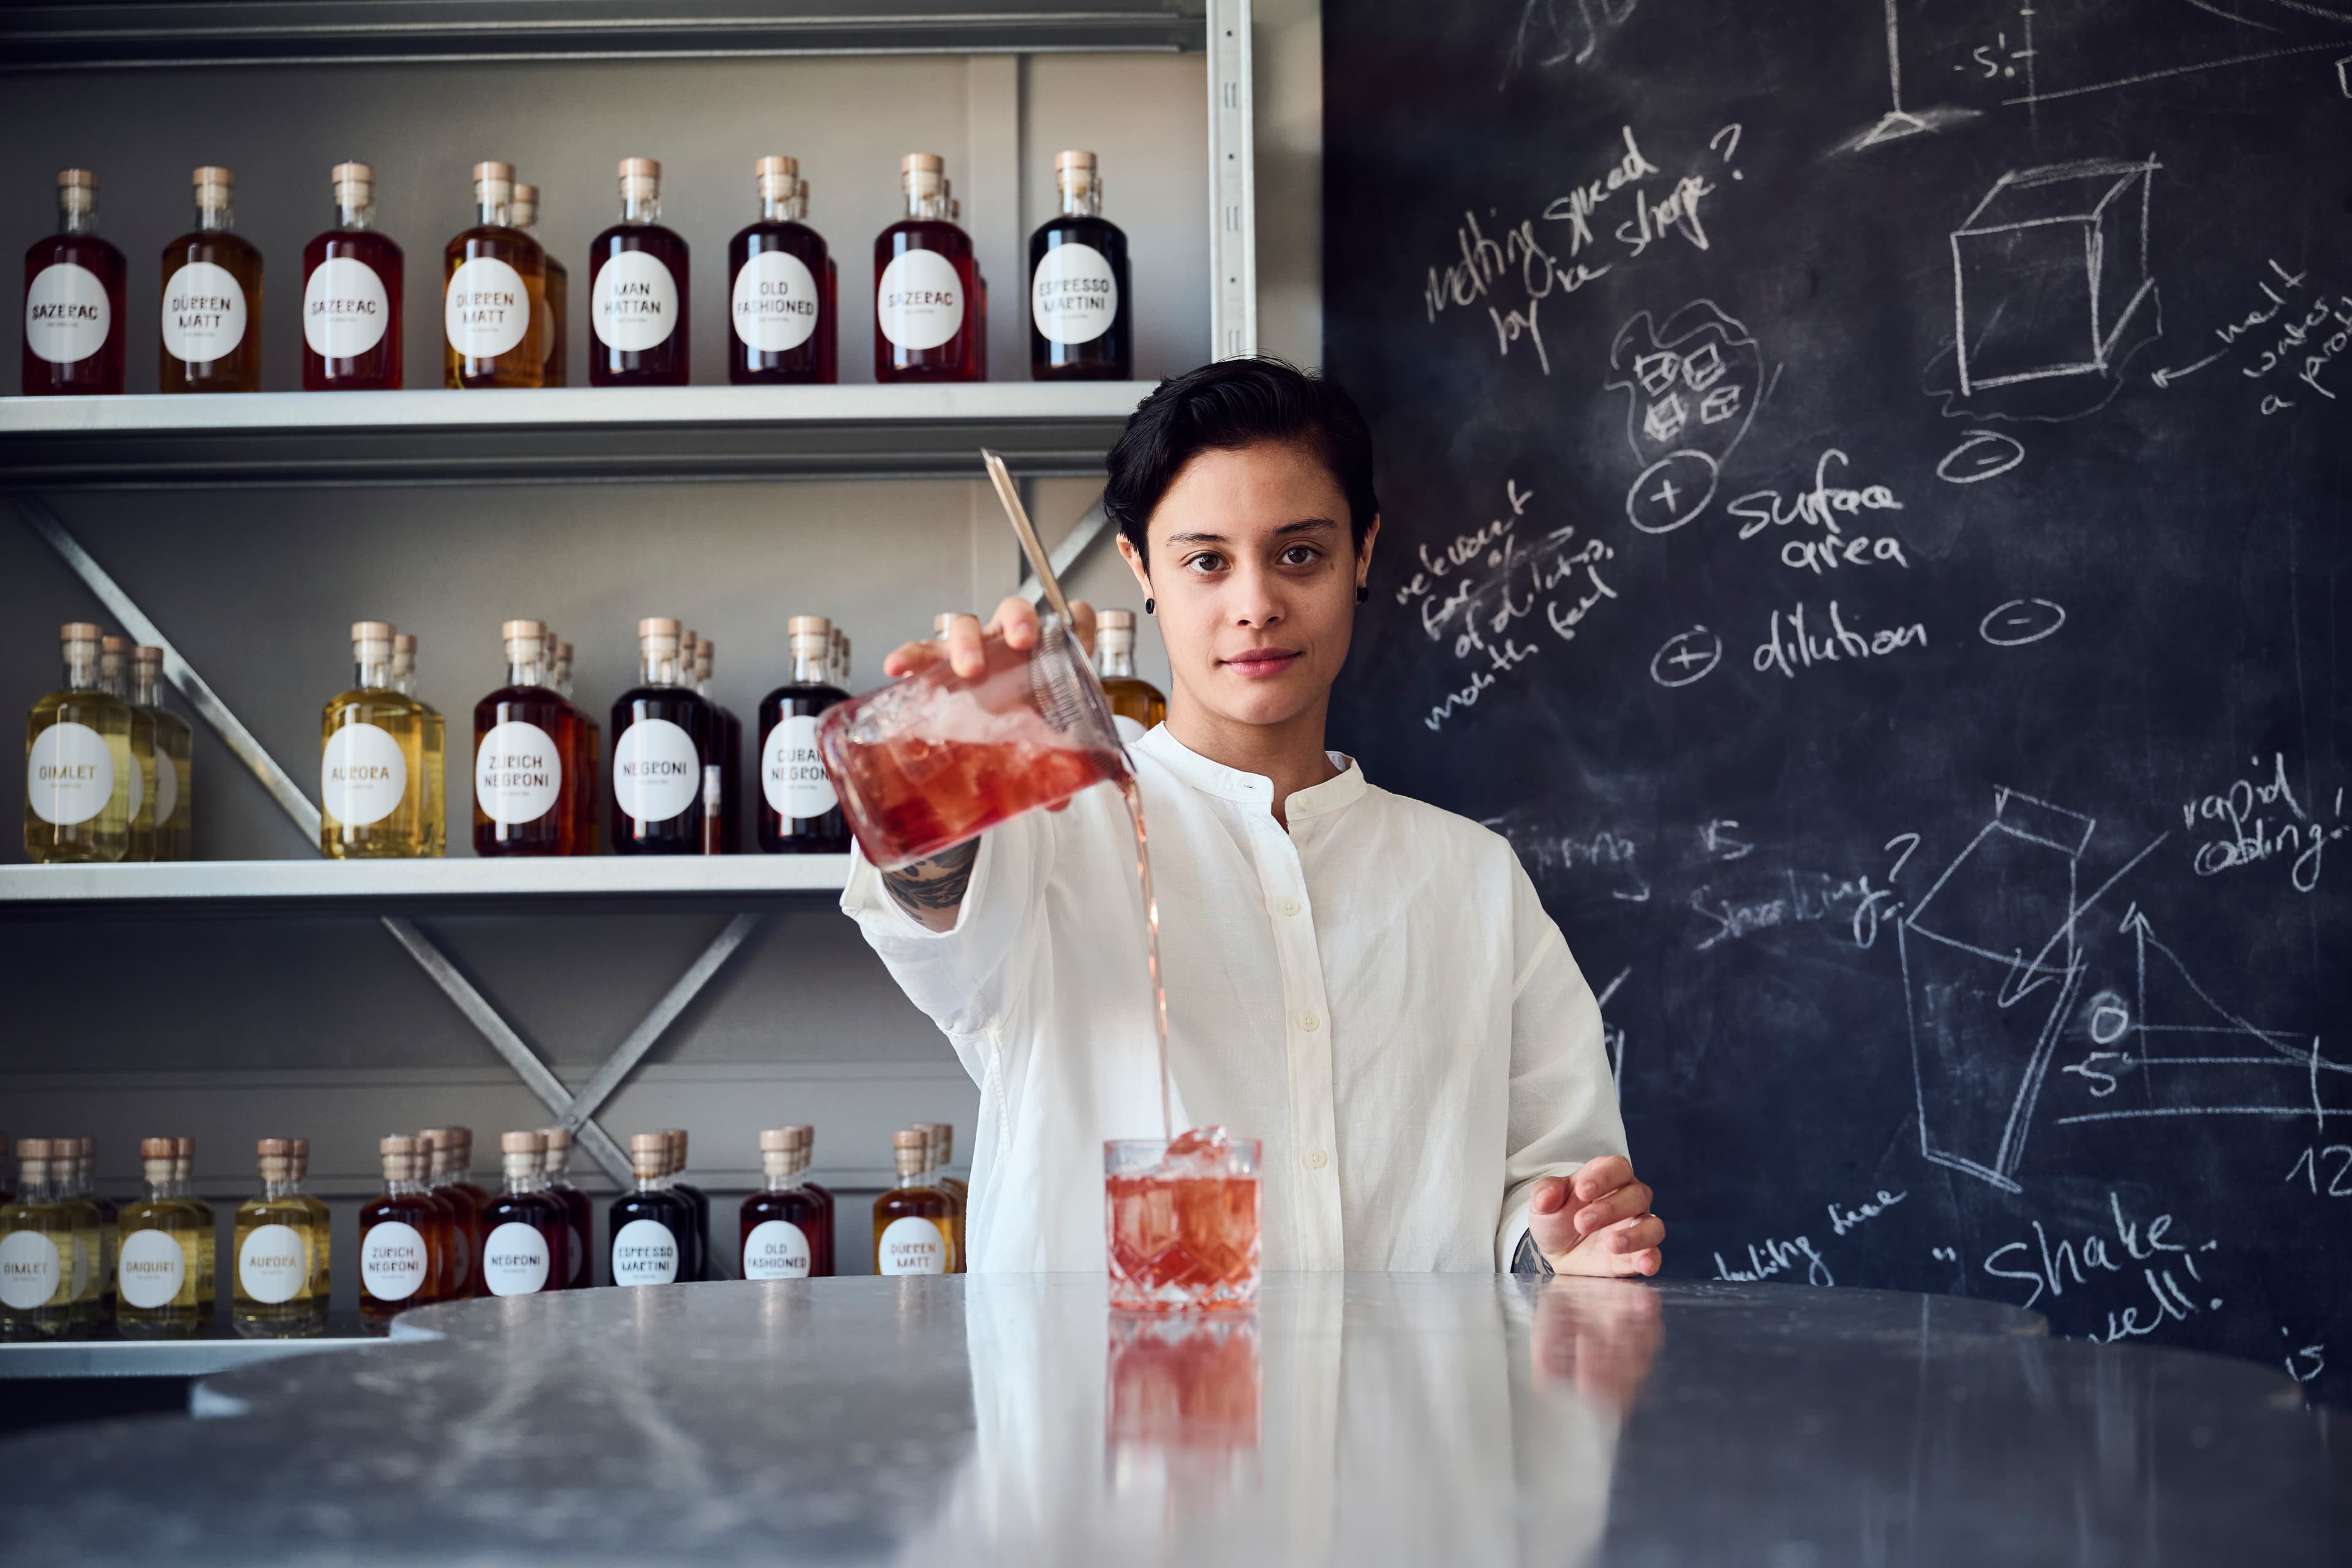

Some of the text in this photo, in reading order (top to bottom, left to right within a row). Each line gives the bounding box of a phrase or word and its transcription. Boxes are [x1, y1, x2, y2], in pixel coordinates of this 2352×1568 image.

[614, 282, 650, 296] MAN
[760, 281, 788, 296] OLD
[1039, 278, 1109, 297] ESPRESSO
[311, 300, 377, 315] SAZERAC
[604, 300, 661, 315] HATTAN
[888, 292, 954, 308] SAZERAC
[1044, 296, 1105, 313] MARTINI
[32, 304, 99, 320] SAZERAC
[736, 299, 815, 317] FASHIONED
[179, 313, 221, 329] MATT
[1781, 534, 1909, 575] area
[1753, 599, 1928, 677] dilution
[39, 764, 97, 780] GIMLET
[332, 766, 391, 782] AURORA
[623, 761, 687, 777] NEGRONI
[772, 766, 831, 782] NEGRON
[484, 772, 549, 788] NEGRONI
[618, 1246, 674, 1259] ESPRESSO
[765, 1243, 788, 1255] OLD
[126, 1261, 175, 1274] DAIQUIRI
[250, 1256, 296, 1268] AURORA
[369, 1260, 419, 1272] NEGRONI
[492, 1254, 541, 1266] NEGRONI
[622, 1260, 669, 1272] MARTINI
[747, 1256, 807, 1269] FASHIONED
[4, 1262, 48, 1275] GIMLET
